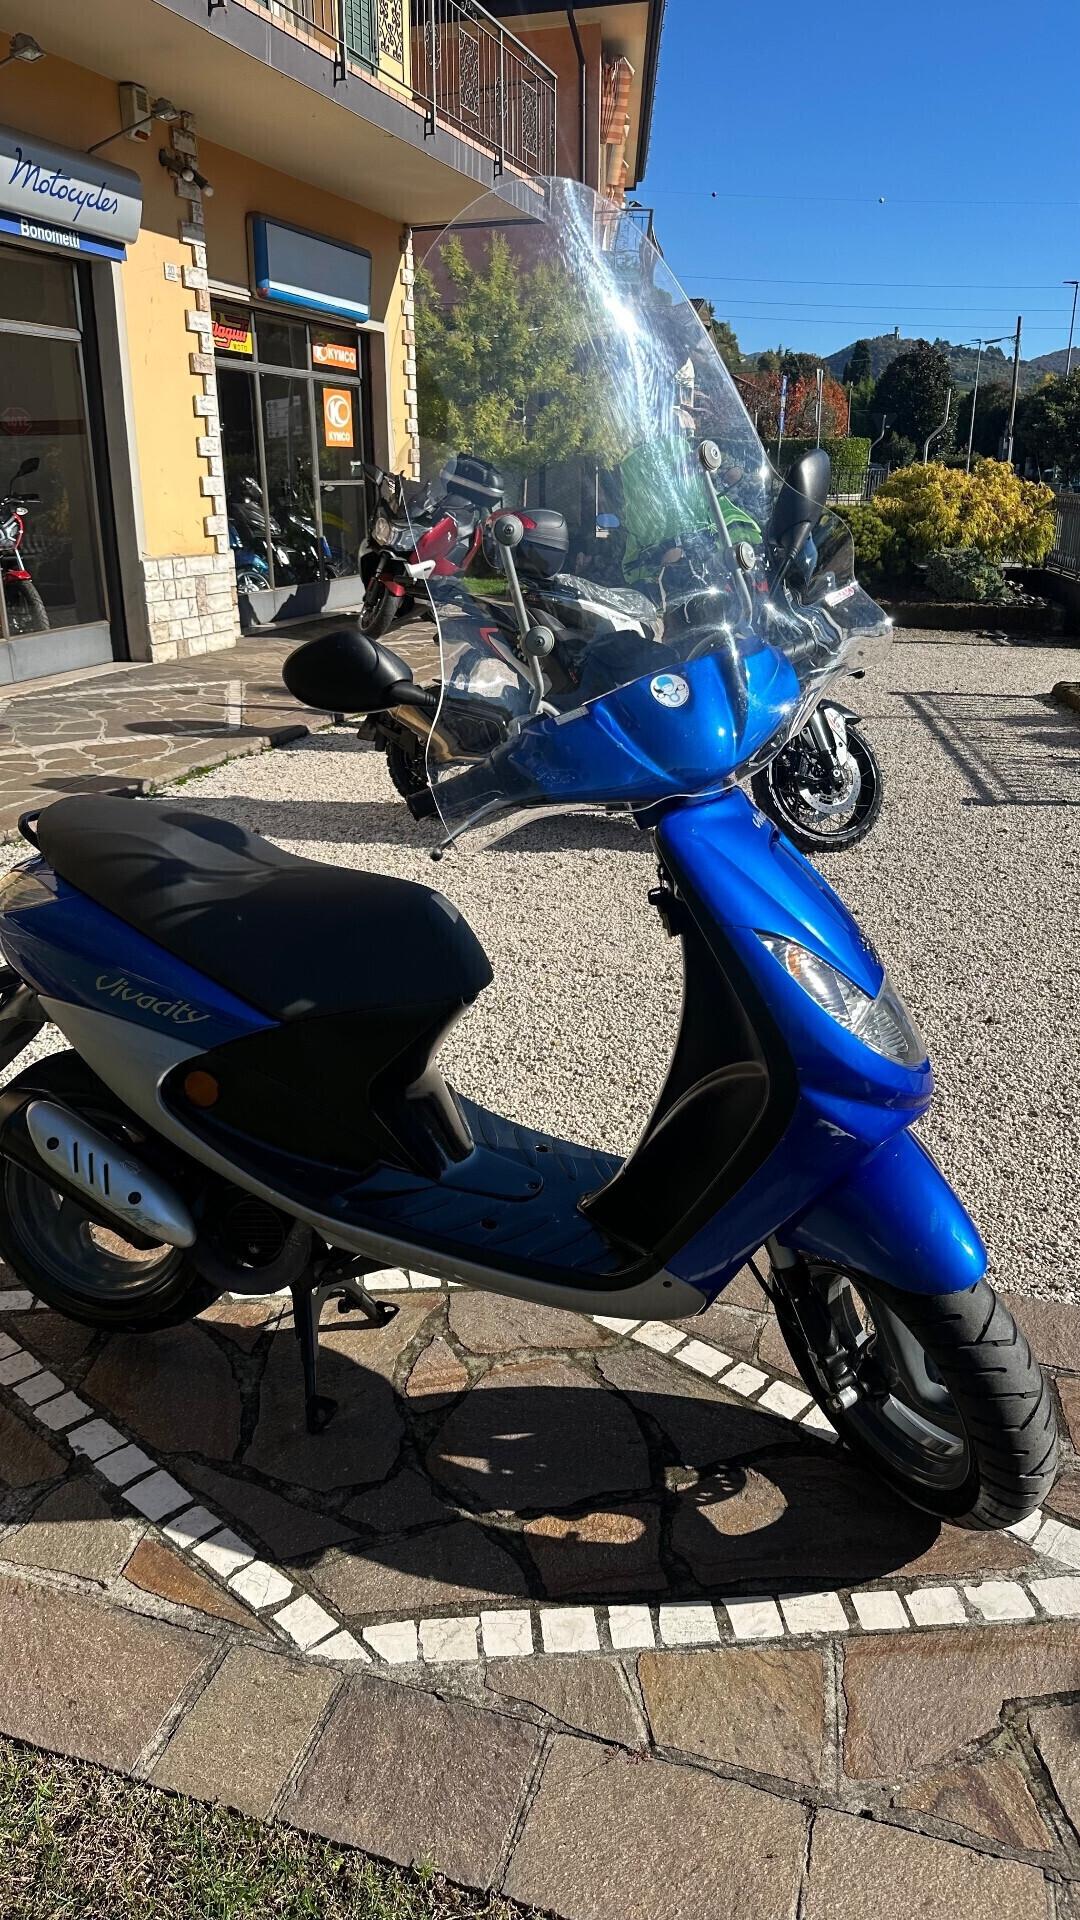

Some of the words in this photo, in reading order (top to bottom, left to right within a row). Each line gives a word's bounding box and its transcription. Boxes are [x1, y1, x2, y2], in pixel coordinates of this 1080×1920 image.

[9, 147, 118, 222] Motocycles
[20, 218, 81, 250] Bonometti
[327, 347, 356, 364] KYMCO
[328, 431, 351, 442] KYMCO
[95, 975, 211, 1024] Vivacity
